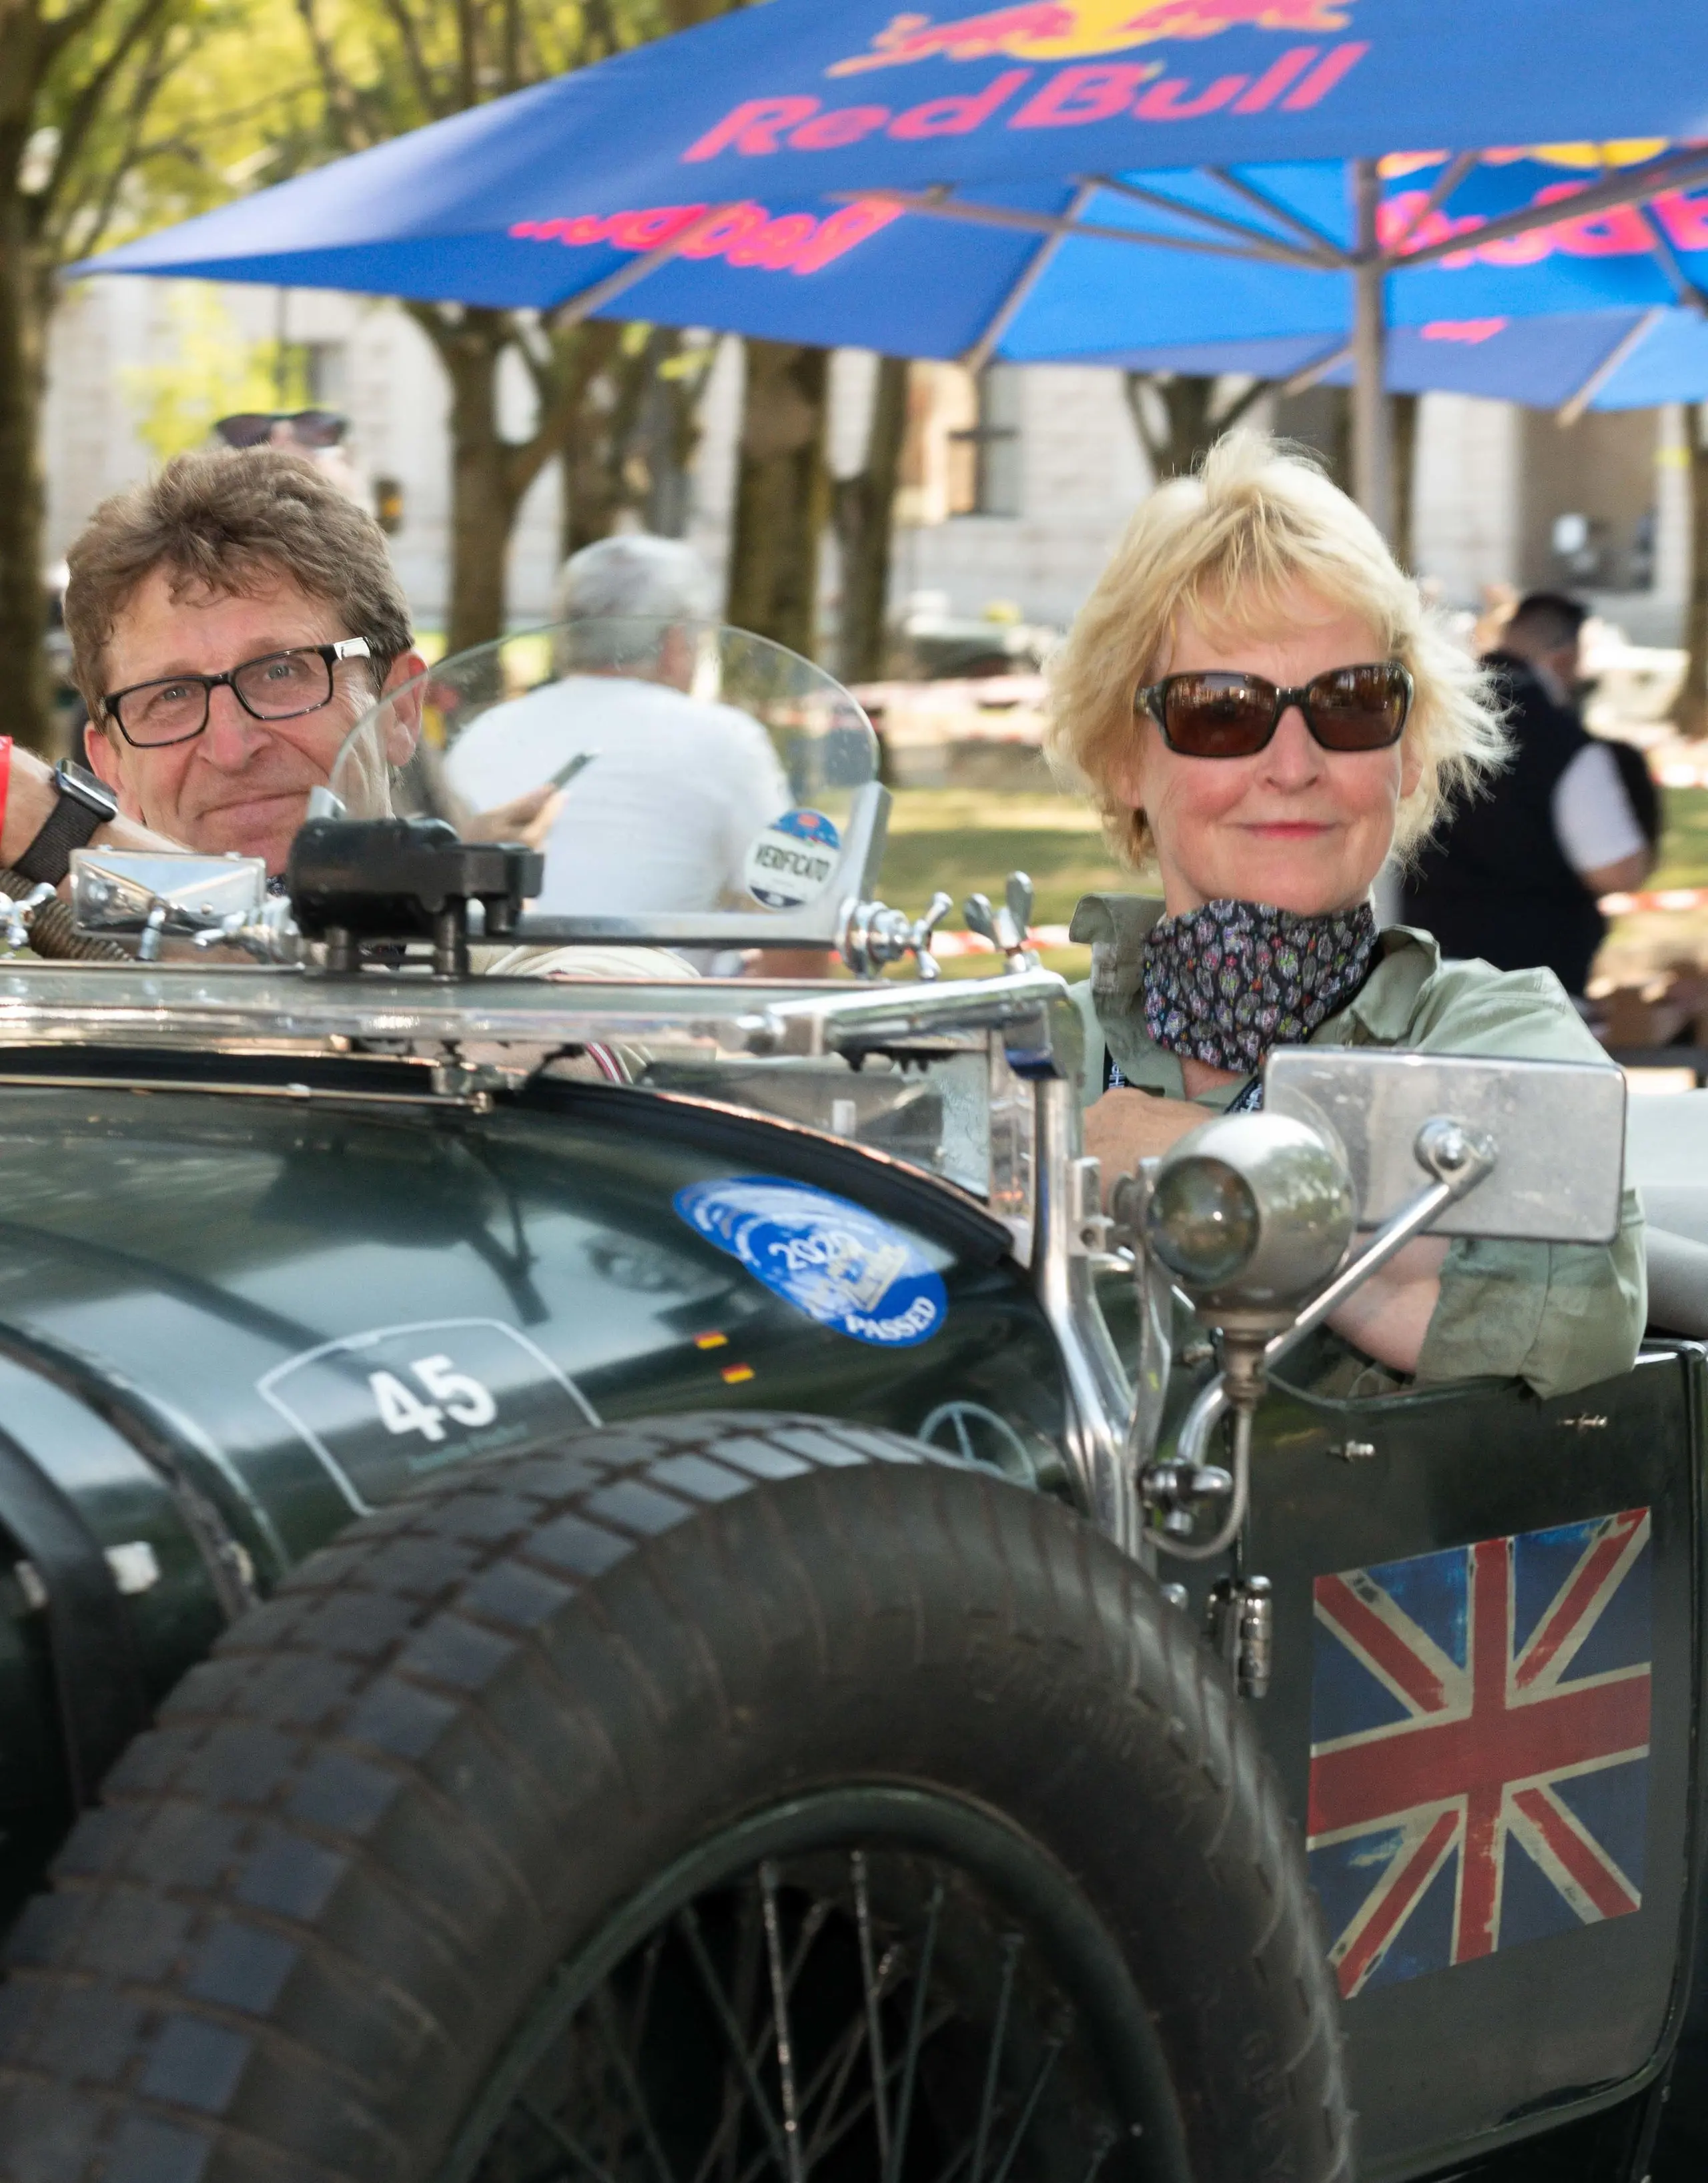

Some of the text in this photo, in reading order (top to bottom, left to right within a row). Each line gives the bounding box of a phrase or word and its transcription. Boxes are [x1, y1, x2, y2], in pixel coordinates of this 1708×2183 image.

[684, 44, 1368, 161] Red Bull
[755, 844, 831, 882] VERIFICATO
[845, 1296, 936, 1340] PASSED
[370, 1354, 496, 1441] 45
